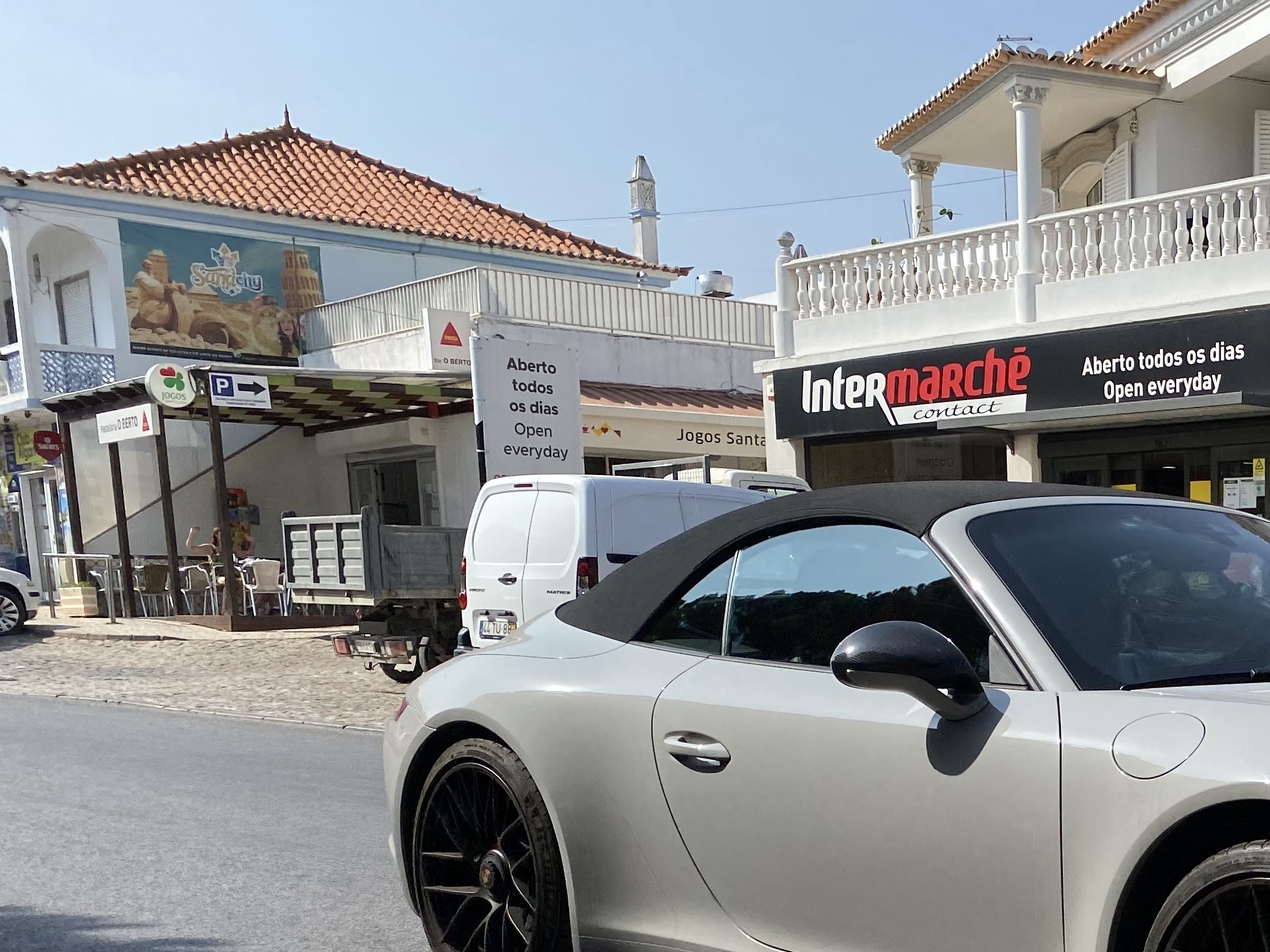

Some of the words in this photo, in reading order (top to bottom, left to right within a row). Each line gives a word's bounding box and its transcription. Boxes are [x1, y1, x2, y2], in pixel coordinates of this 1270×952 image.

[506, 357, 556, 374] Aberto
[1081, 354, 1135, 376] Aberto
[1138, 348, 1183, 369] todos
[1186, 347, 1206, 365] os
[1210, 340, 1245, 362] dias
[512, 378, 554, 394] todos
[1104, 380, 1144, 403] Open
[1147, 371, 1222, 396] everyday
[162, 391, 186, 400] JOGOS
[510, 402, 526, 412] os
[530, 401, 558, 415] dias
[913, 400, 1003, 421] contact
[514, 422, 552, 438] Open
[676, 428, 721, 444] Jogos
[504, 444, 568, 461] everyday
